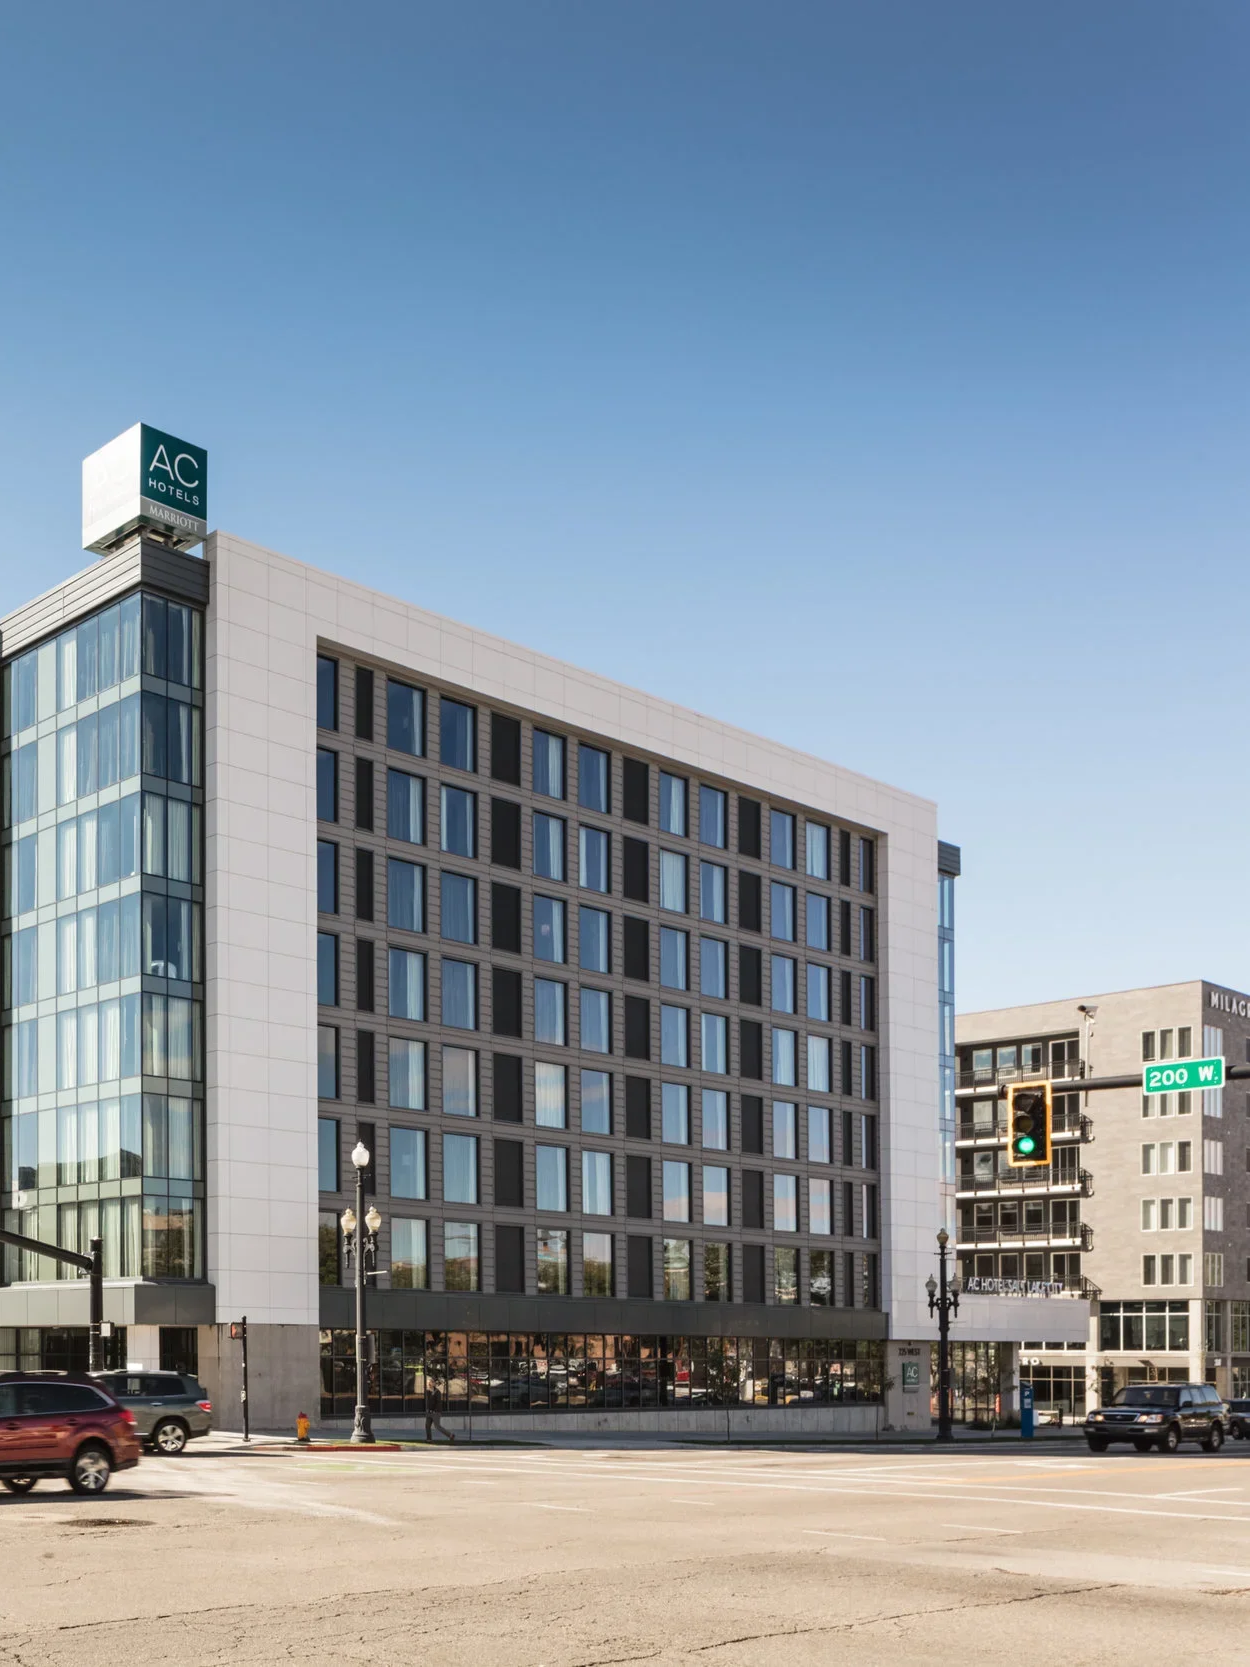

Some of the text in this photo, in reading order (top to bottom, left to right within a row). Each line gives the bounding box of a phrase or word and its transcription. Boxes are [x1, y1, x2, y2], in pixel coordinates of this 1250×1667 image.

[150, 444, 199, 488] AC
[148, 477, 200, 506] HOTELS
[149, 505, 199, 532] MARRIOTT
[1149, 1068, 1189, 1088] 200
[967, 1276, 980, 1291] AC
[981, 1277, 1007, 1293] HOTEL
[906, 1366, 918, 1378] AC
